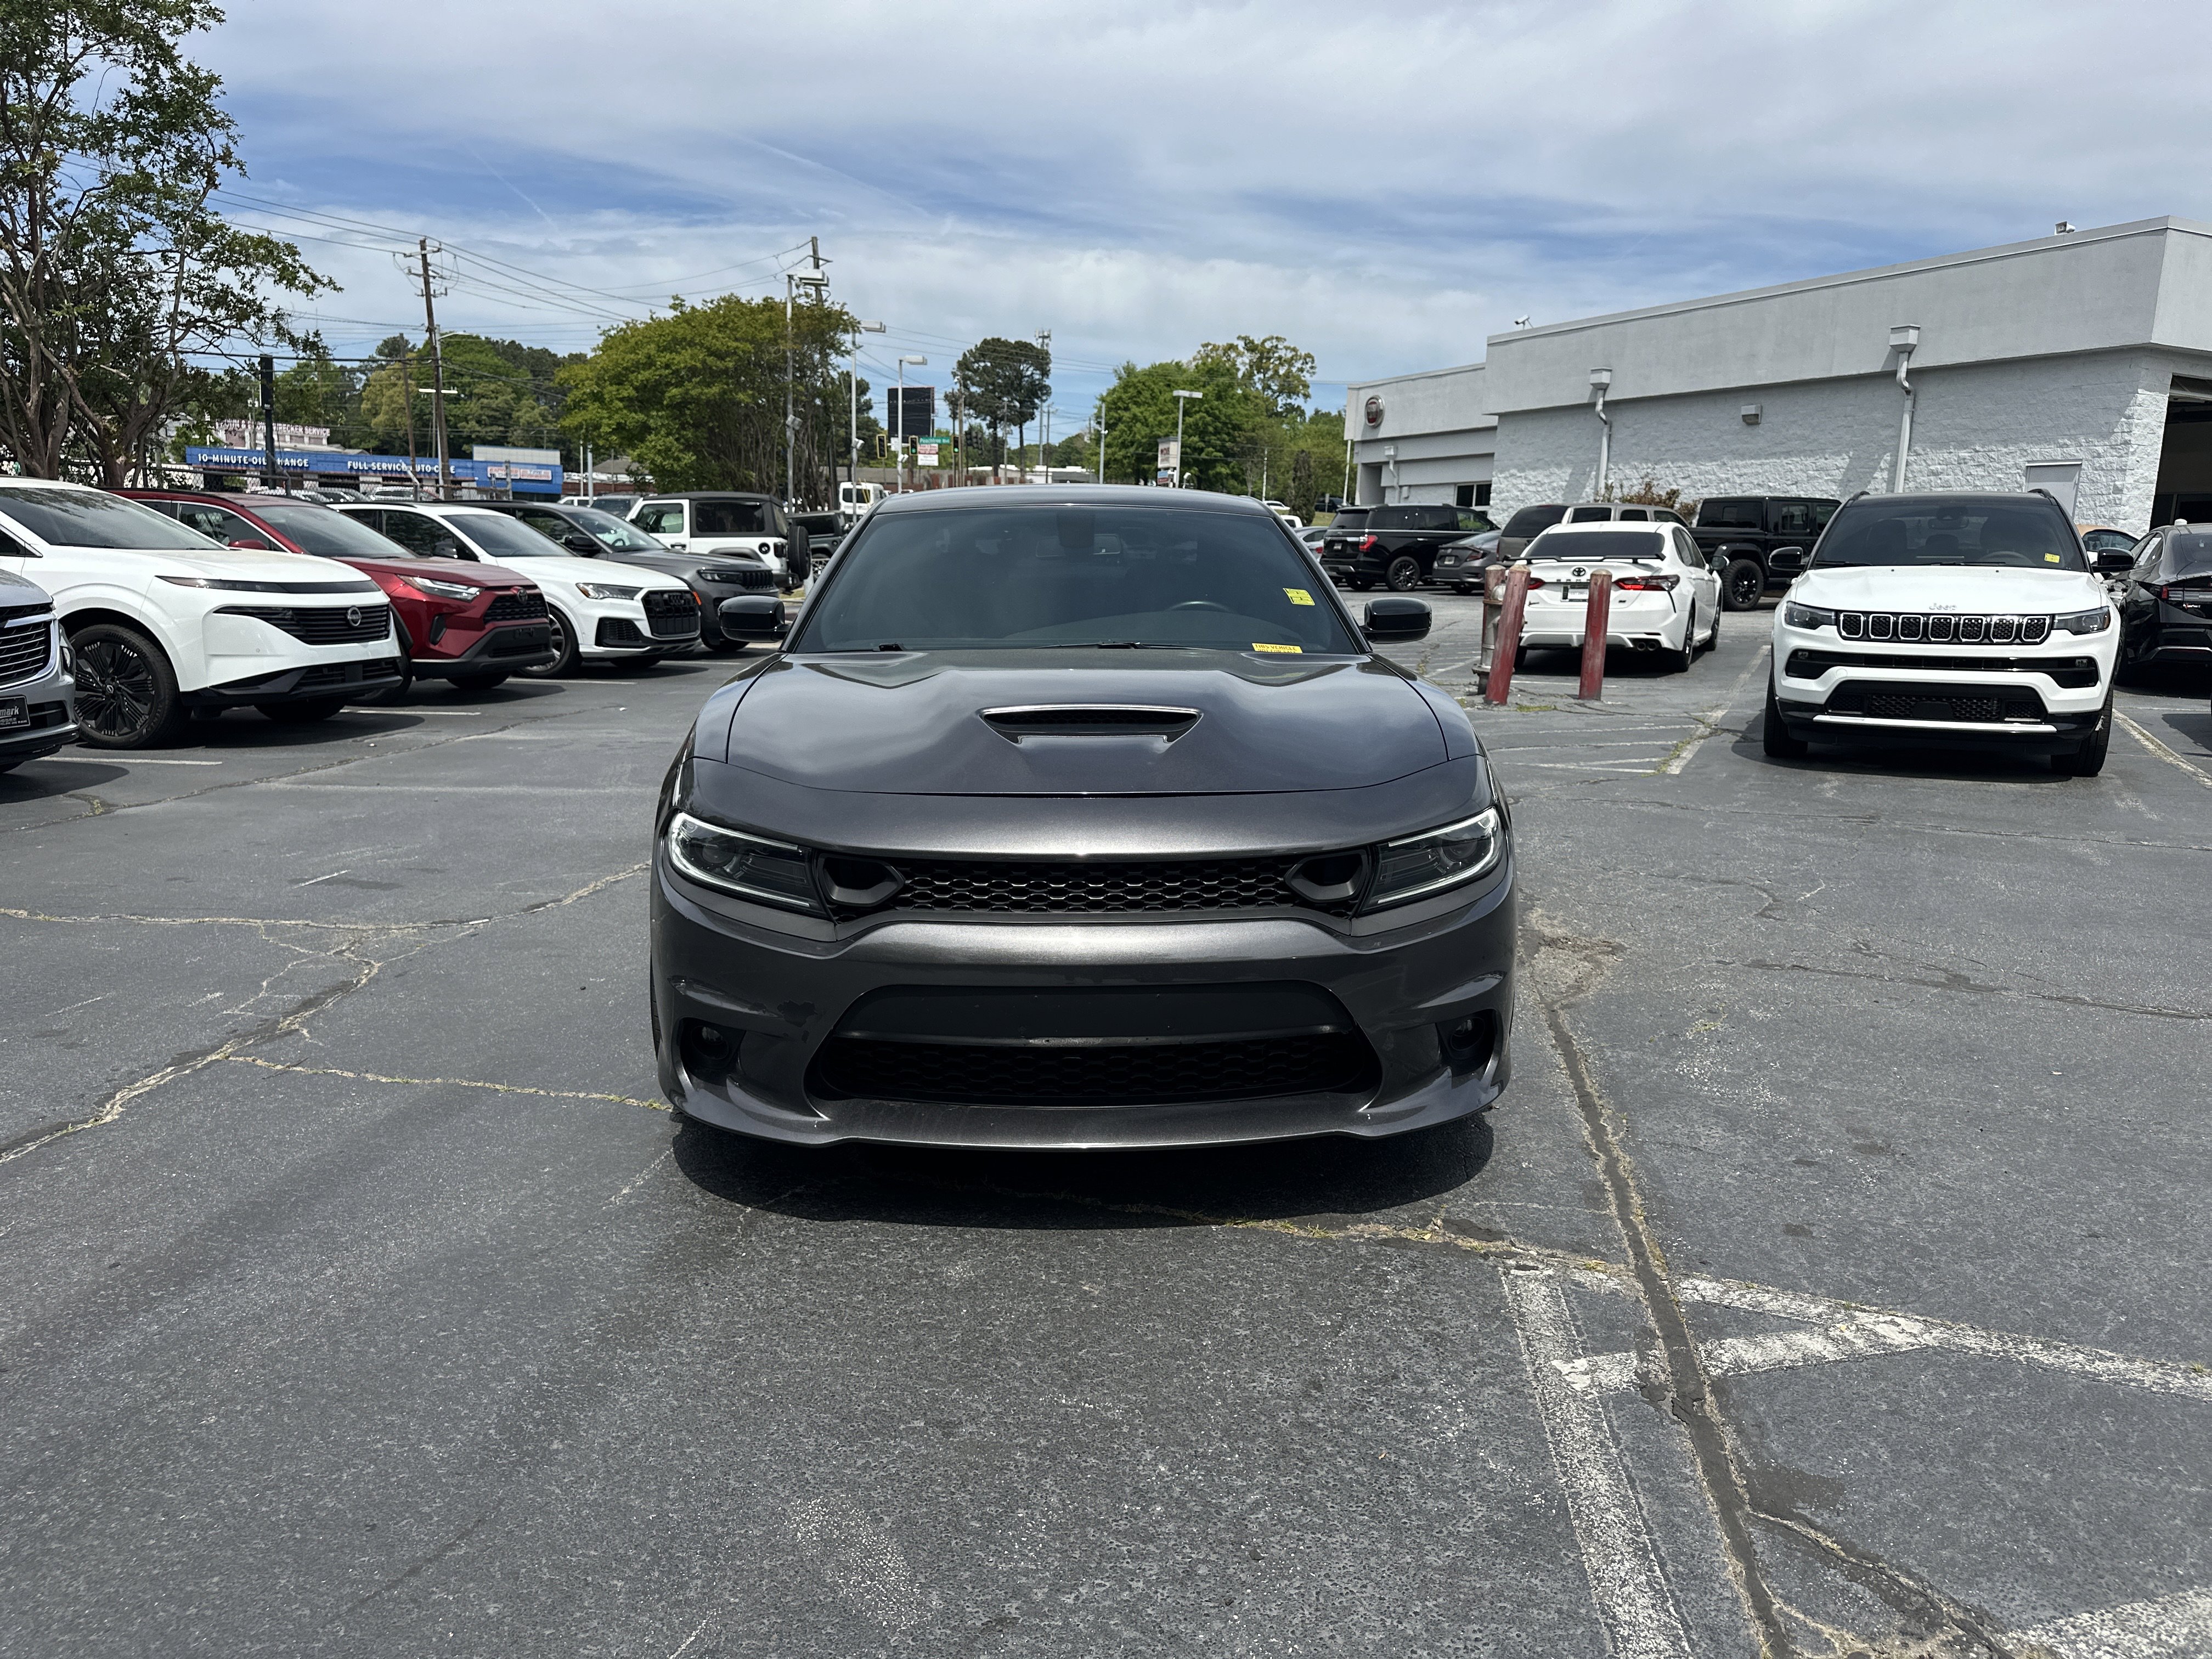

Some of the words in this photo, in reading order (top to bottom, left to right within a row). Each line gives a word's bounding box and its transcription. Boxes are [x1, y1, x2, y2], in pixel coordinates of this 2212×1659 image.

[304, 425, 330, 437] SERVICE
[252, 456, 267, 465] OIL
[276, 457, 309, 467] HANGE
[347, 460, 369, 470] FULL
[410, 464, 431, 473] UTO
[433, 465, 455, 474] CE
[1929, 602, 1957, 612] Jeep
